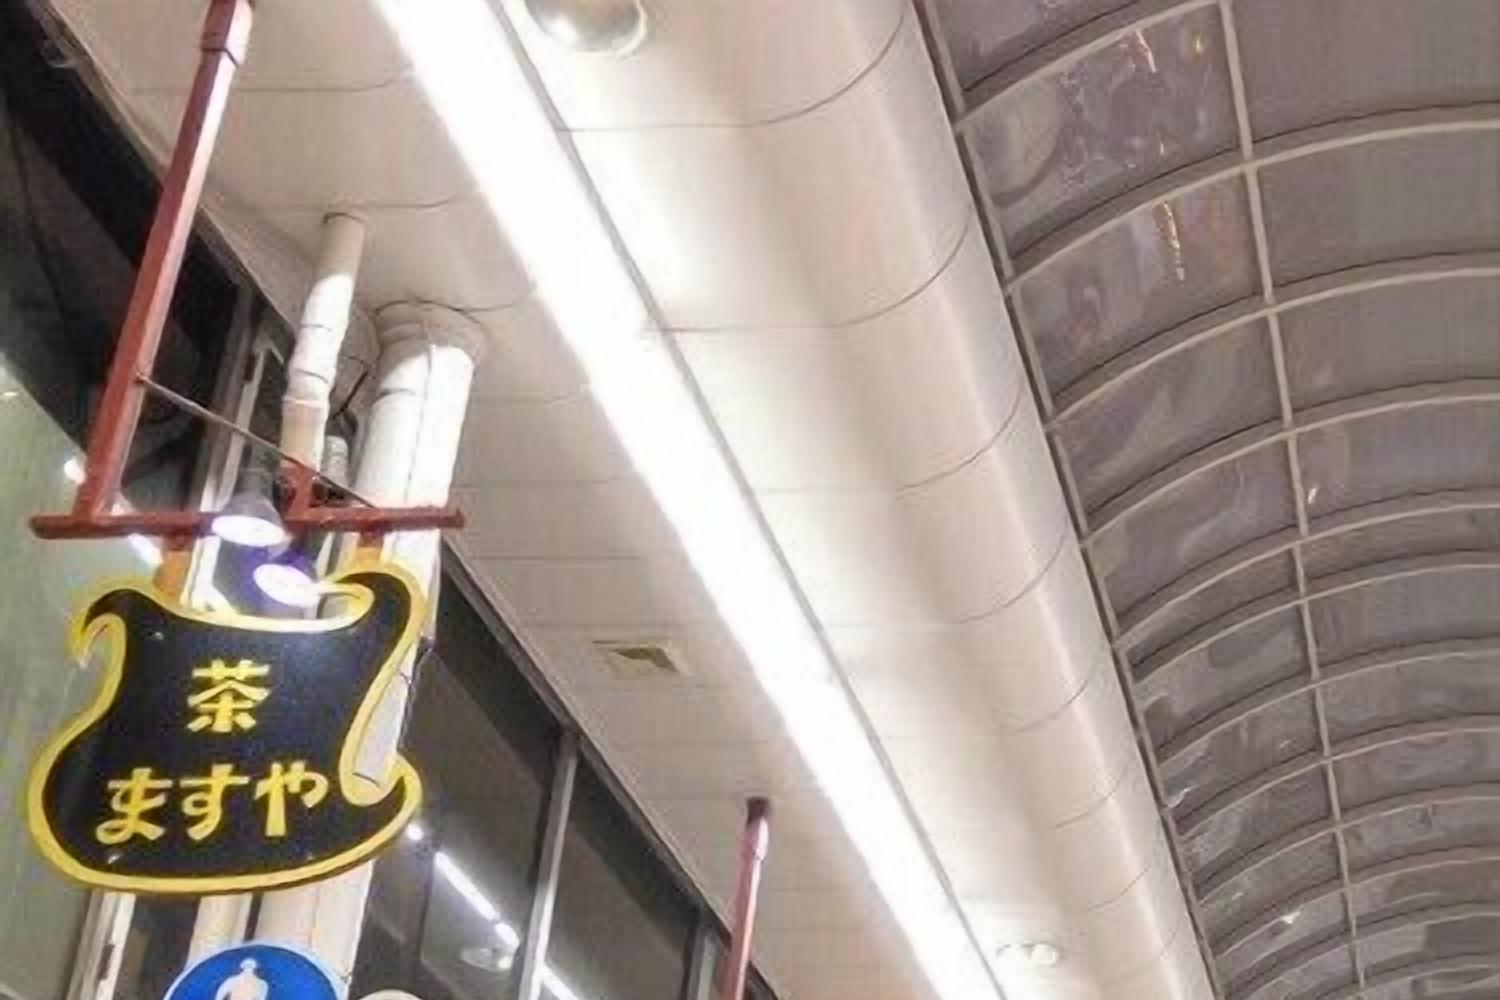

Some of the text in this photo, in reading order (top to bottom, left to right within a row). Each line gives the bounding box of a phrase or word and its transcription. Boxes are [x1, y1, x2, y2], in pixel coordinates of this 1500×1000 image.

[187, 659, 271, 734] 茶
[96, 759, 329, 845] ますや
